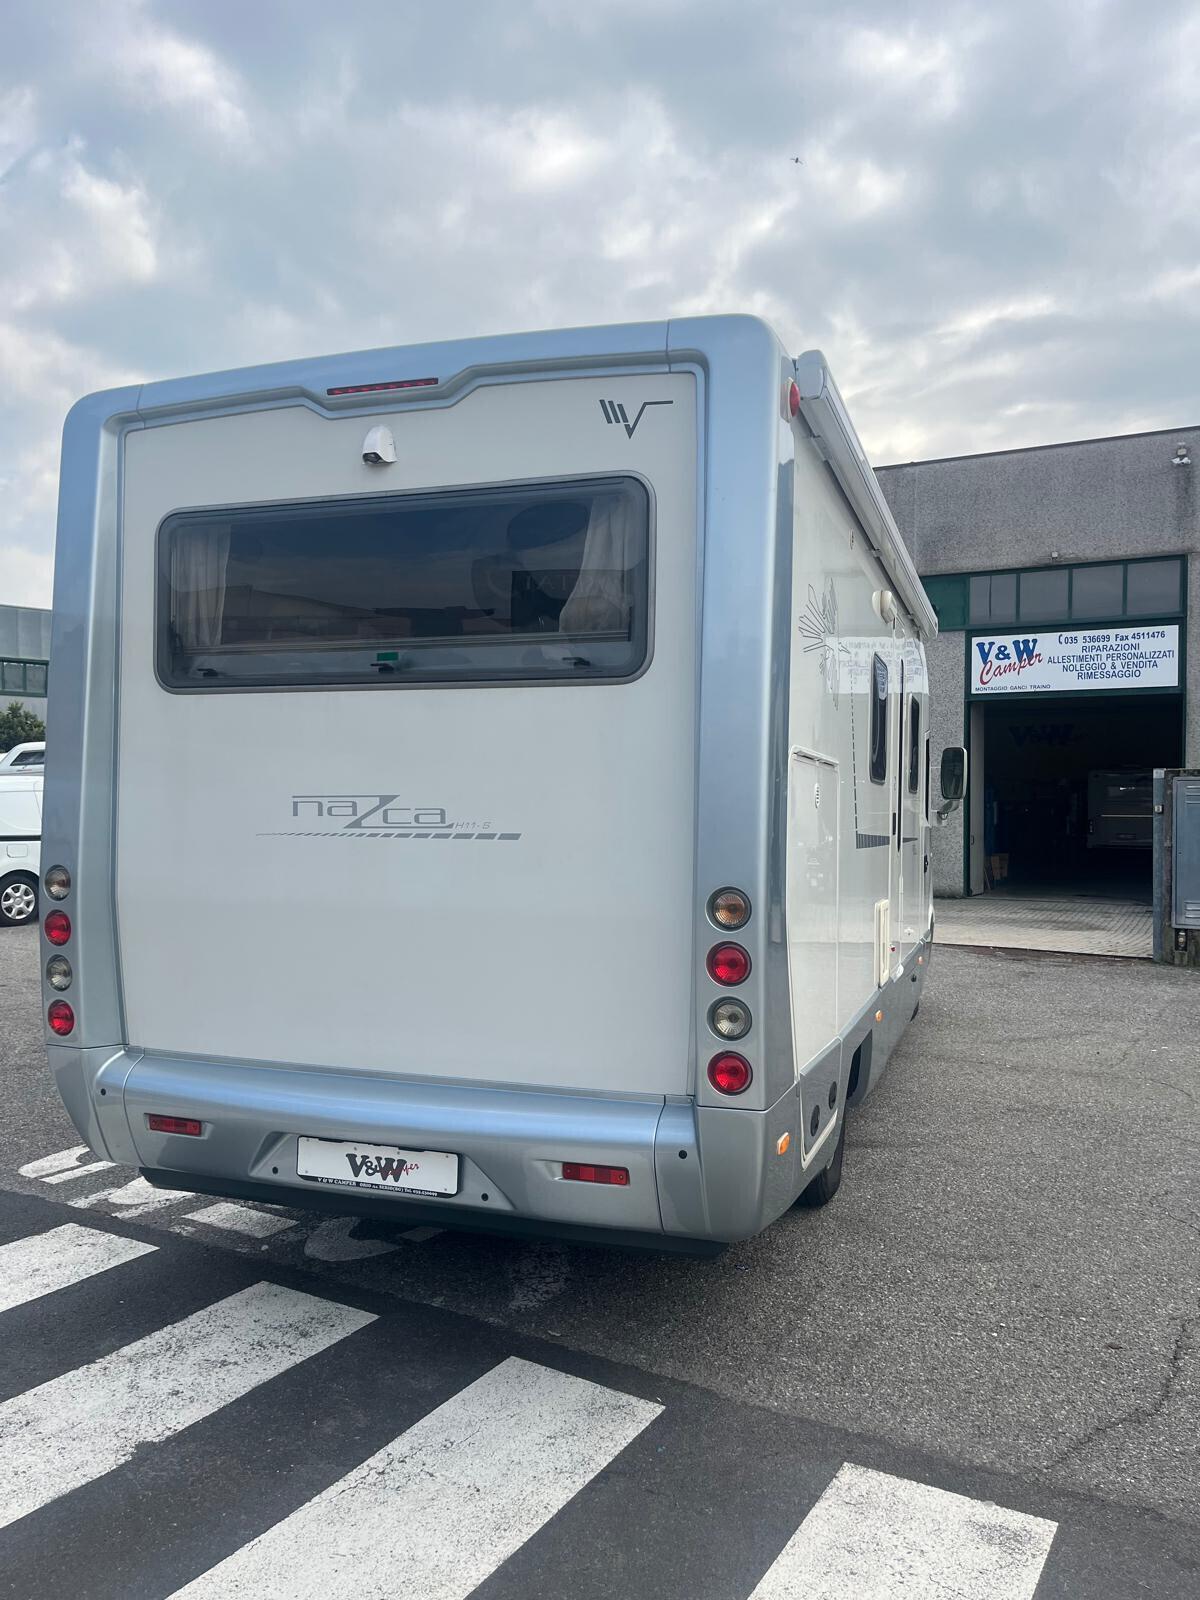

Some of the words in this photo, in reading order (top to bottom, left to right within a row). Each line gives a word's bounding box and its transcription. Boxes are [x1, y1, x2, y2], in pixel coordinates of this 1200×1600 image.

[1064, 636, 1078, 644] 035
[1082, 635, 1111, 643] 536699
[1115, 633, 1129, 642] Fax
[1131, 631, 1166, 640] 4511476
[1082, 643, 1140, 653] RIPARAZIONI
[1047, 654, 1102, 664] ALLESTIMENTI
[1106, 650, 1174, 661] PERSONALIZZATI
[980, 653, 1043, 685] Camper
[1062, 662, 1106, 672] NOLEGGIO
[1111, 662, 1117, 670] &
[1121, 660, 1158, 669] VENDITA
[1077, 670, 1141, 680] RIMESSAGGIO
